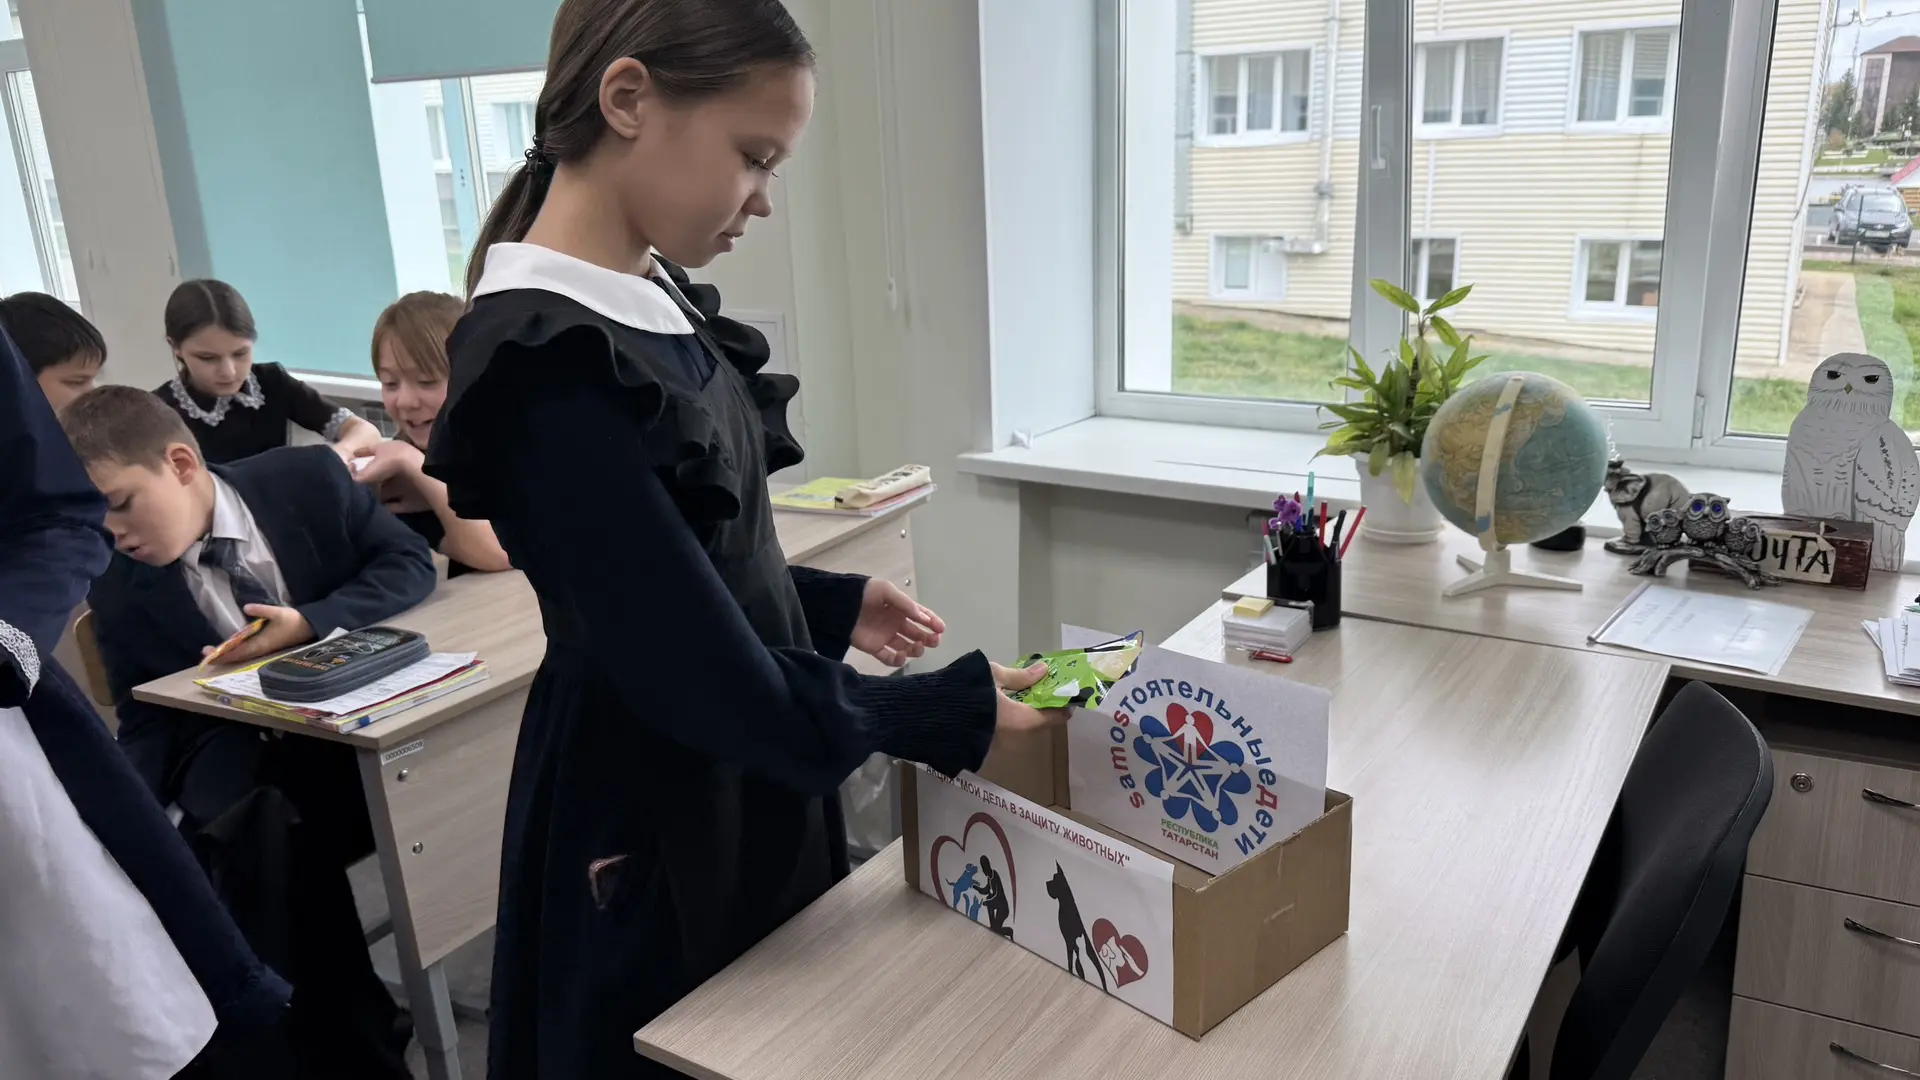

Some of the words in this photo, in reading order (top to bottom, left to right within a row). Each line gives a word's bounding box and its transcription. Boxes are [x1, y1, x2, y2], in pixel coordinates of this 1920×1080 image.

[1749, 534, 1831, 575] ОЧТА
[983, 789, 1008, 811] ДЕЛА
[1010, 802, 1017, 815] В
[1019, 806, 1061, 834] ЗАЩИТУ
[1062, 825, 1131, 867] ЖИВОТНЫХ"
[1160, 818, 1219, 850] РЕСПУБЛИКА
[1160, 828, 1219, 861] ТАТАРСТАН
